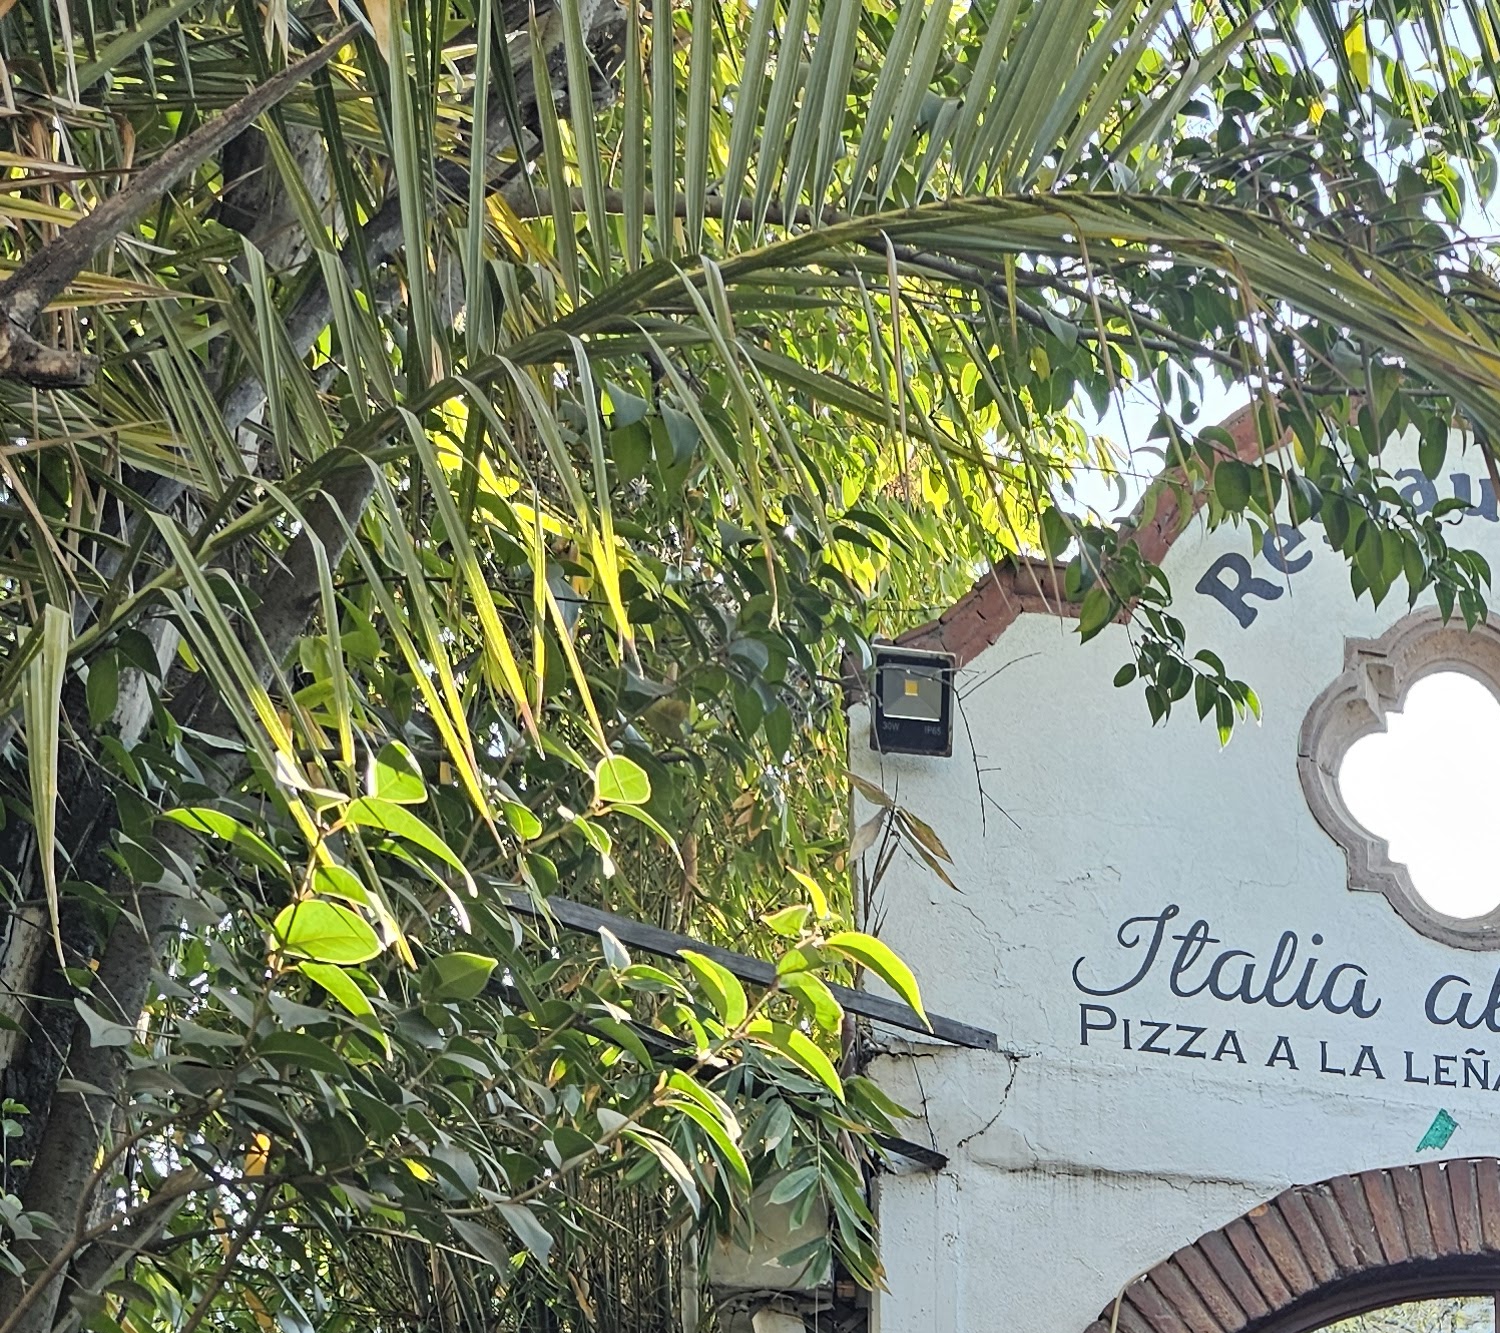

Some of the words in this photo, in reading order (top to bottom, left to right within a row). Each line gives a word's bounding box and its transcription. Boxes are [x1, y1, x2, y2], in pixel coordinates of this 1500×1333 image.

[1072, 904, 1382, 1018] Italia
[1079, 1003, 1248, 1064] PIZZA
[1265, 1035, 1300, 1071] A
[1320, 1041, 1386, 1080] LA
